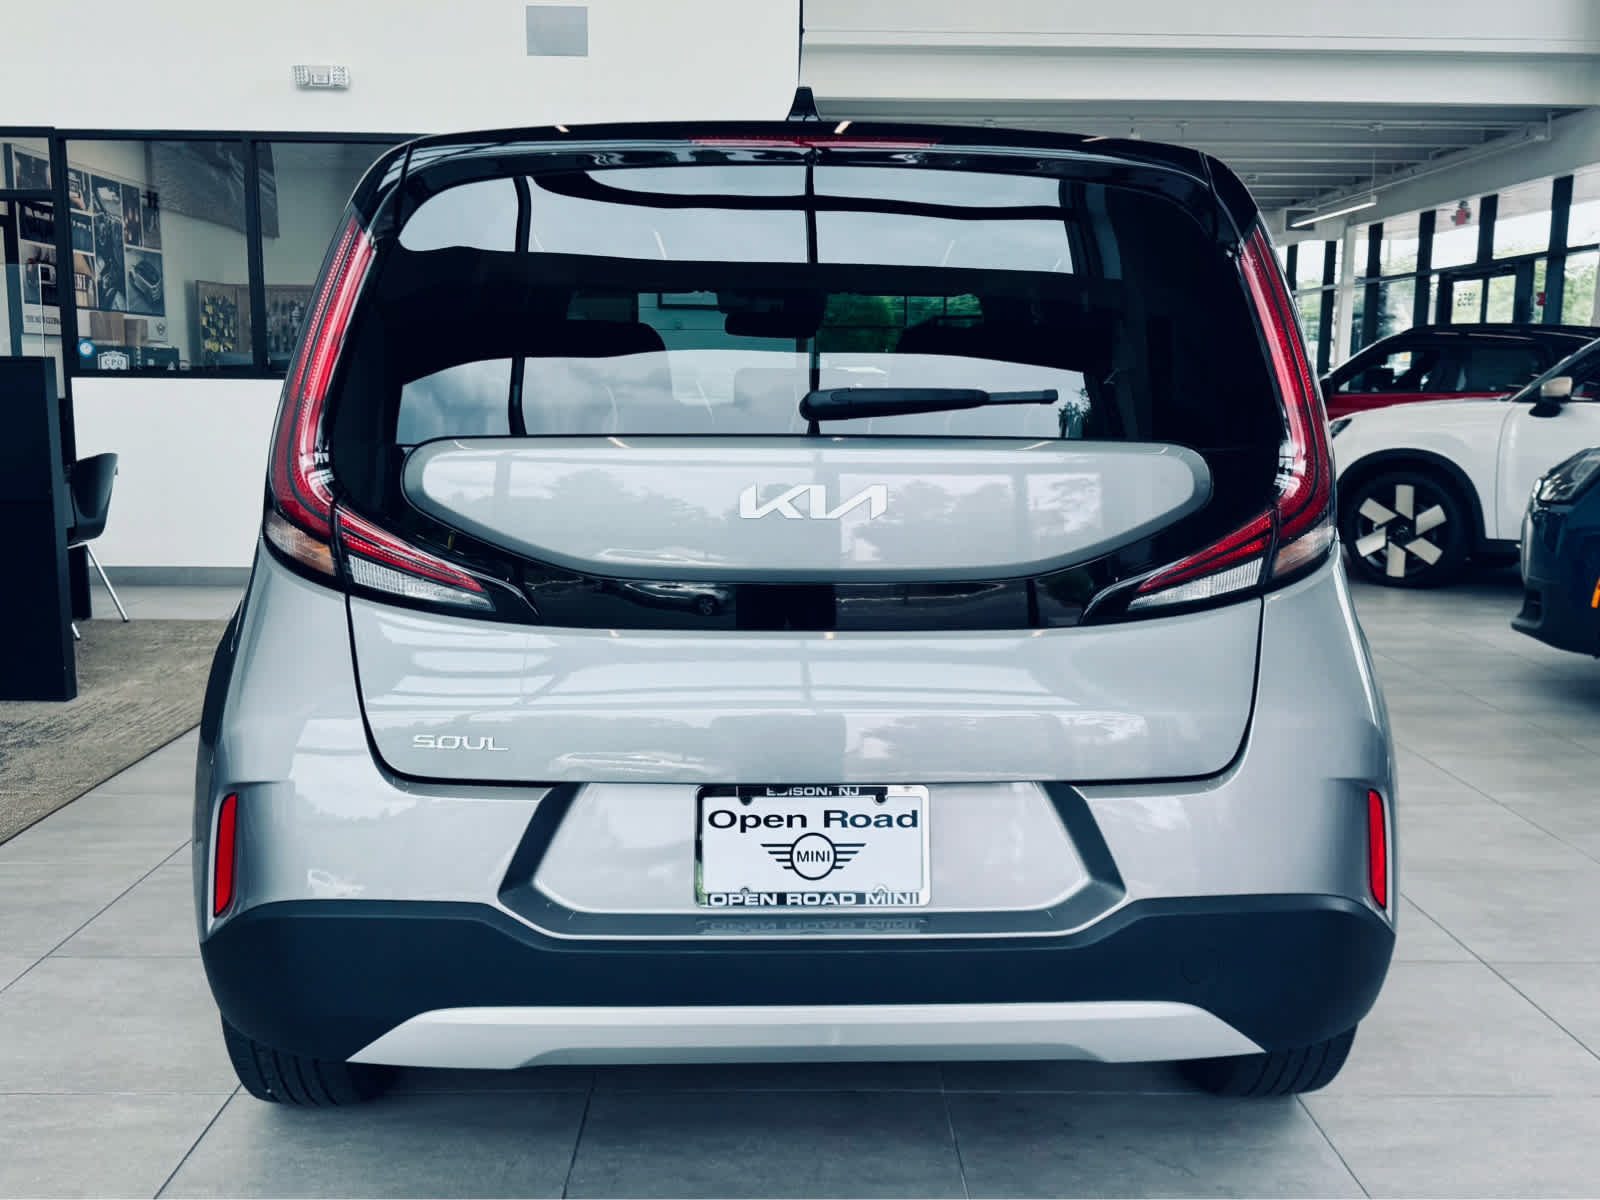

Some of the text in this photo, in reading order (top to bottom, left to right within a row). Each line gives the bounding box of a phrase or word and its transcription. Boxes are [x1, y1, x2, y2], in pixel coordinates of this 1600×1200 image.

[740, 483, 888, 520] KIA
[412, 734, 509, 751] SOUL
[838, 787, 860, 796] NJ
[708, 809, 919, 834] Open Road
[796, 850, 831, 862] MINI
[709, 892, 920, 906] OPEN ROAD MINI
